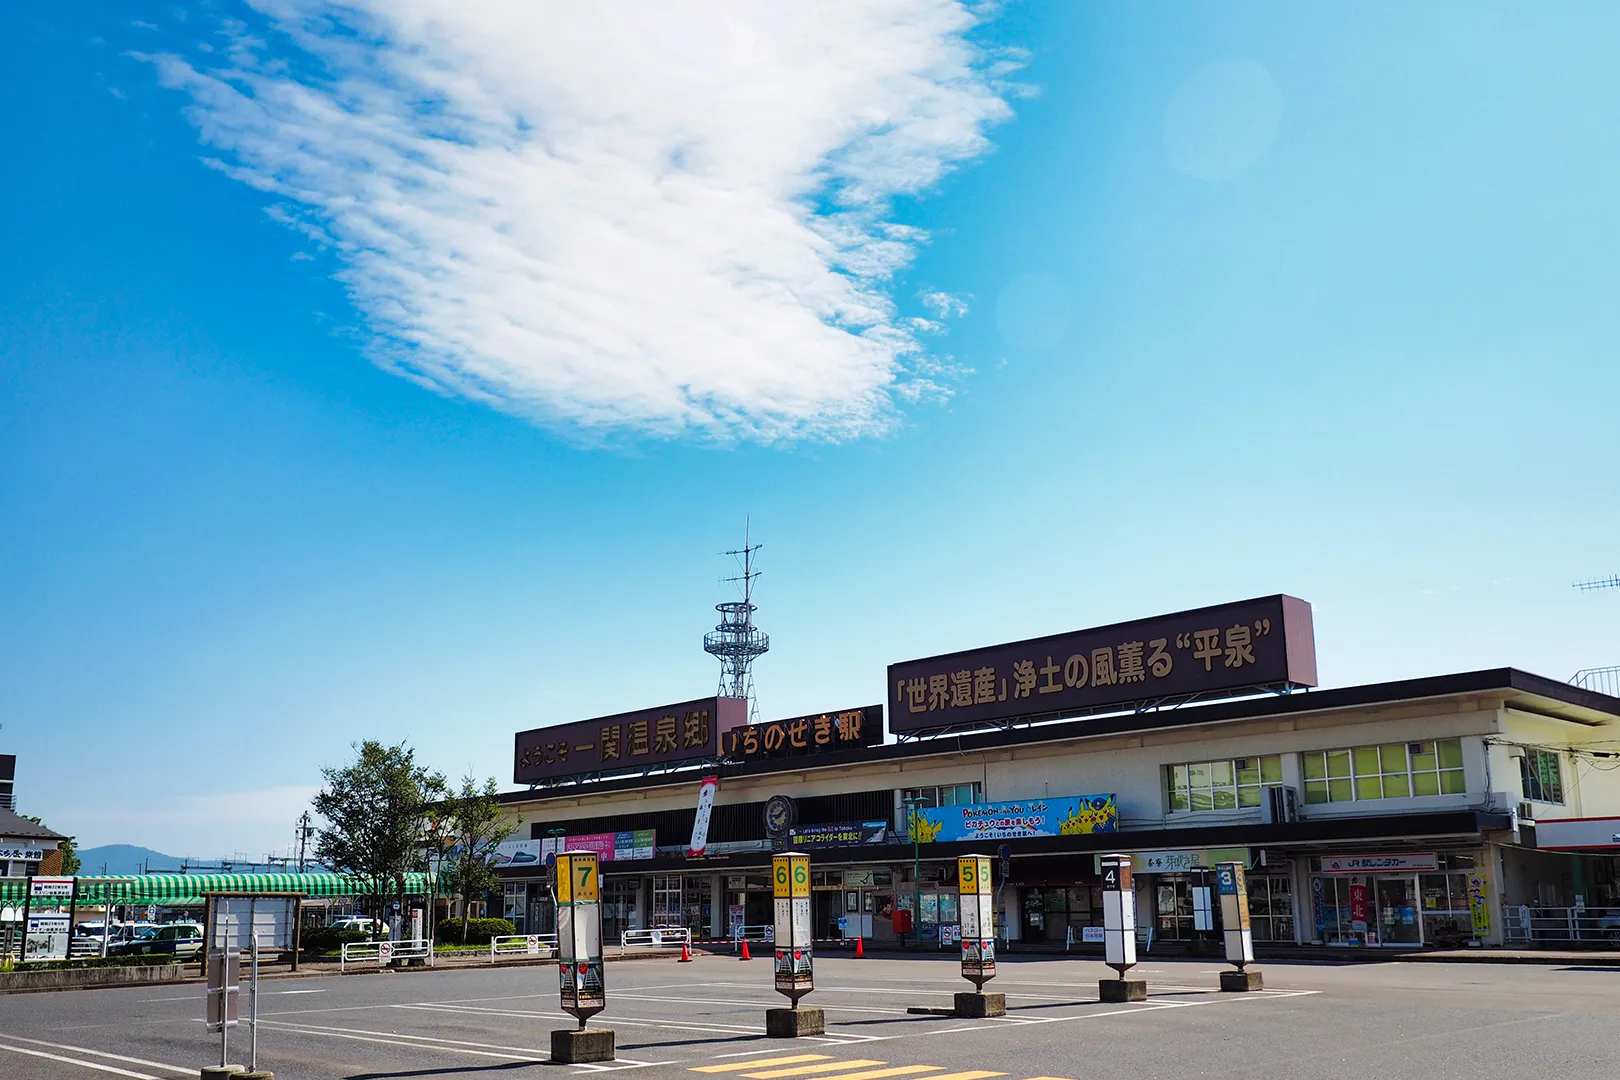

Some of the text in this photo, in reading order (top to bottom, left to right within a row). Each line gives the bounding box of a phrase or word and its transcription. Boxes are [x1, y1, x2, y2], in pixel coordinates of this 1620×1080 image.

[719, 710, 862, 756] いちのせき駅
[1010, 804, 1025, 815] YOU
[1348, 859, 1360, 867] JR
[577, 866, 593, 887] 7
[776, 866, 786, 884] 6
[795, 865, 806, 884] 6
[963, 866, 974, 882] 5
[981, 866, 989, 882] 5
[1105, 869, 1116, 884] 4
[1220, 871, 1232, 885] 3
[1352, 888, 1364, 918] 東北
